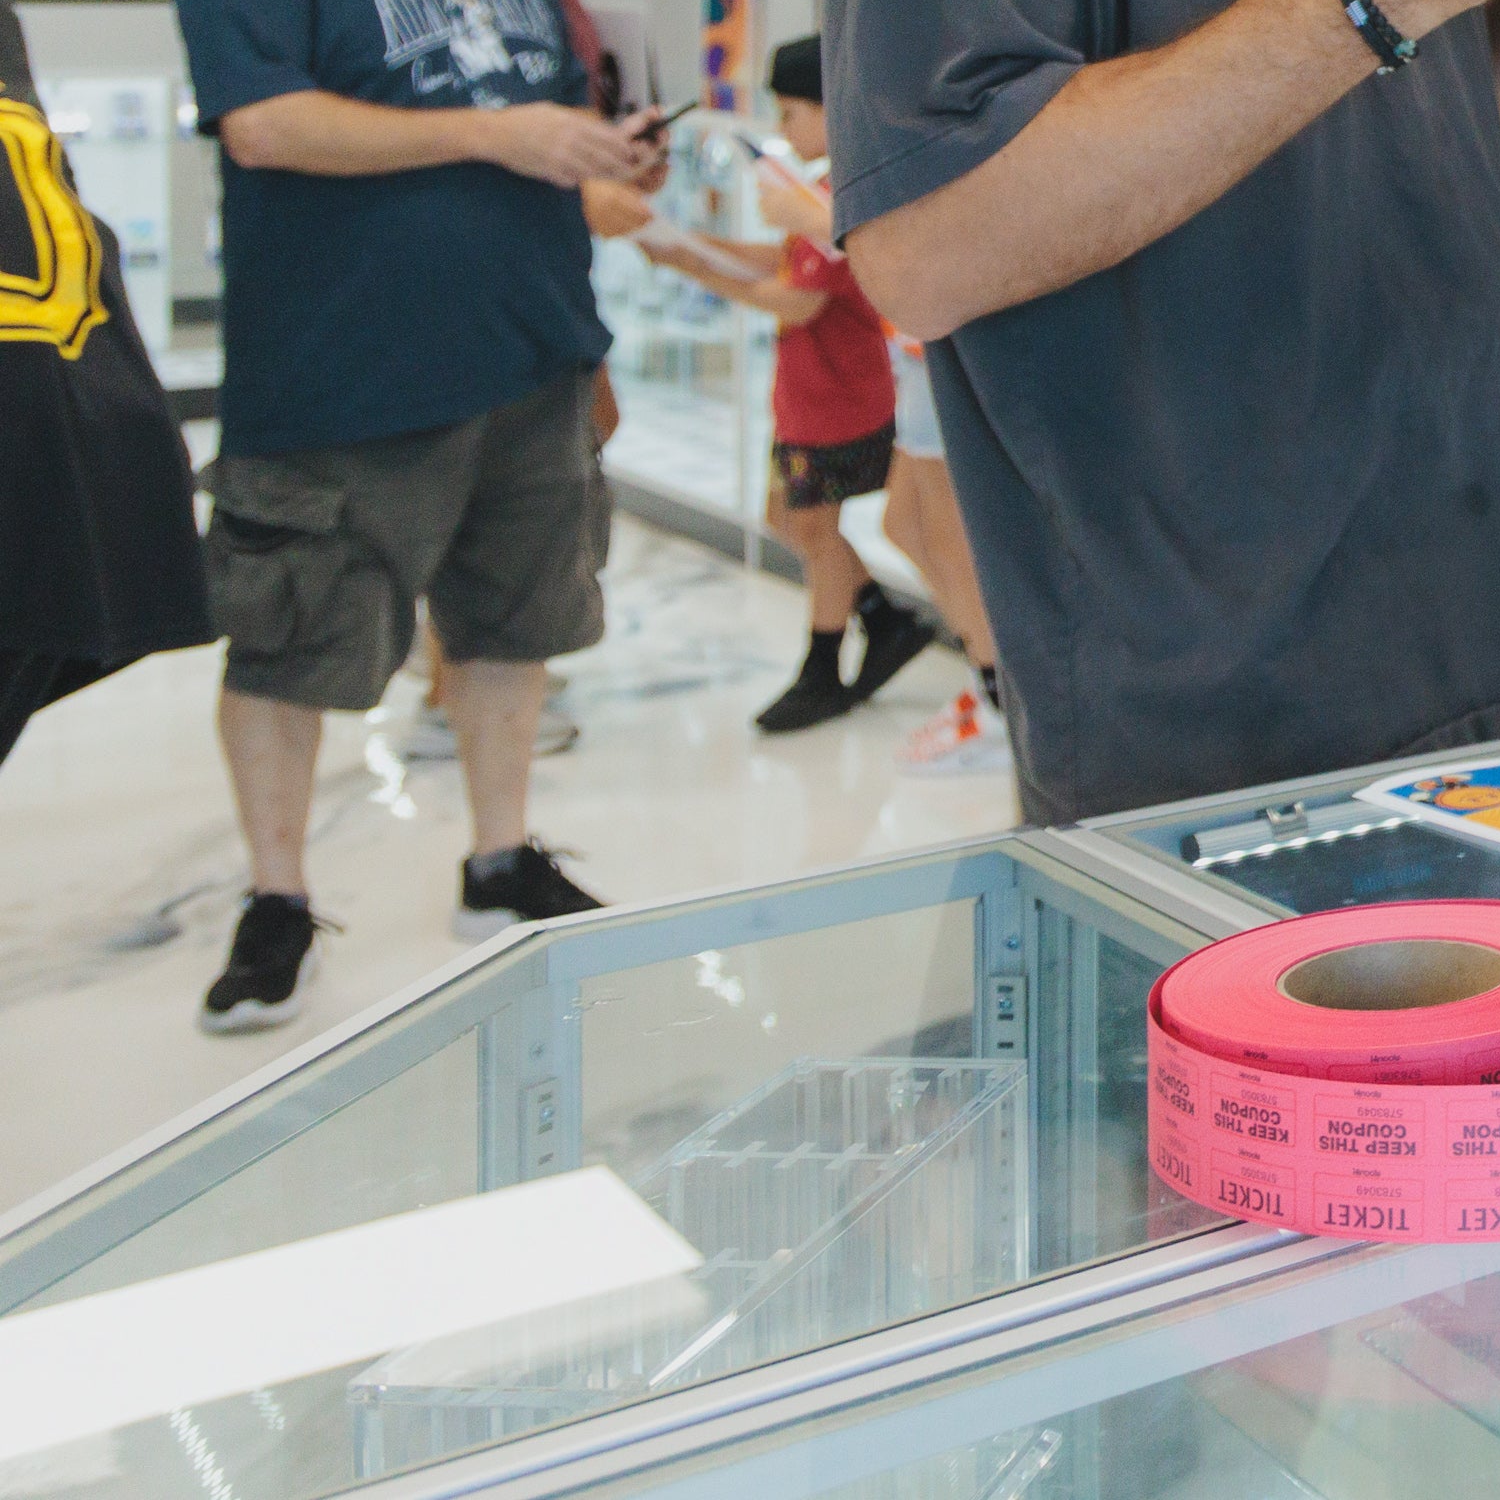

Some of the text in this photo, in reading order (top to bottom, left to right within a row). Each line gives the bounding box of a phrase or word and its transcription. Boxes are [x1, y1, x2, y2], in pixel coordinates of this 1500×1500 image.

[1171, 1094, 1195, 1116] KEEP
[1220, 1098, 1281, 1125] COUPON
[1357, 1106, 1403, 1118] 5783049
[1214, 1113, 1289, 1143] KEEP THIS
[1328, 1120, 1407, 1139] COUPON
[1319, 1136, 1416, 1156] KEEP THIS
[1452, 1141, 1497, 1156] THIS
[1218, 1179, 1284, 1217] TICKET
[1356, 1185, 1402, 1198] 5783049
[1323, 1203, 1409, 1231] TICKET
